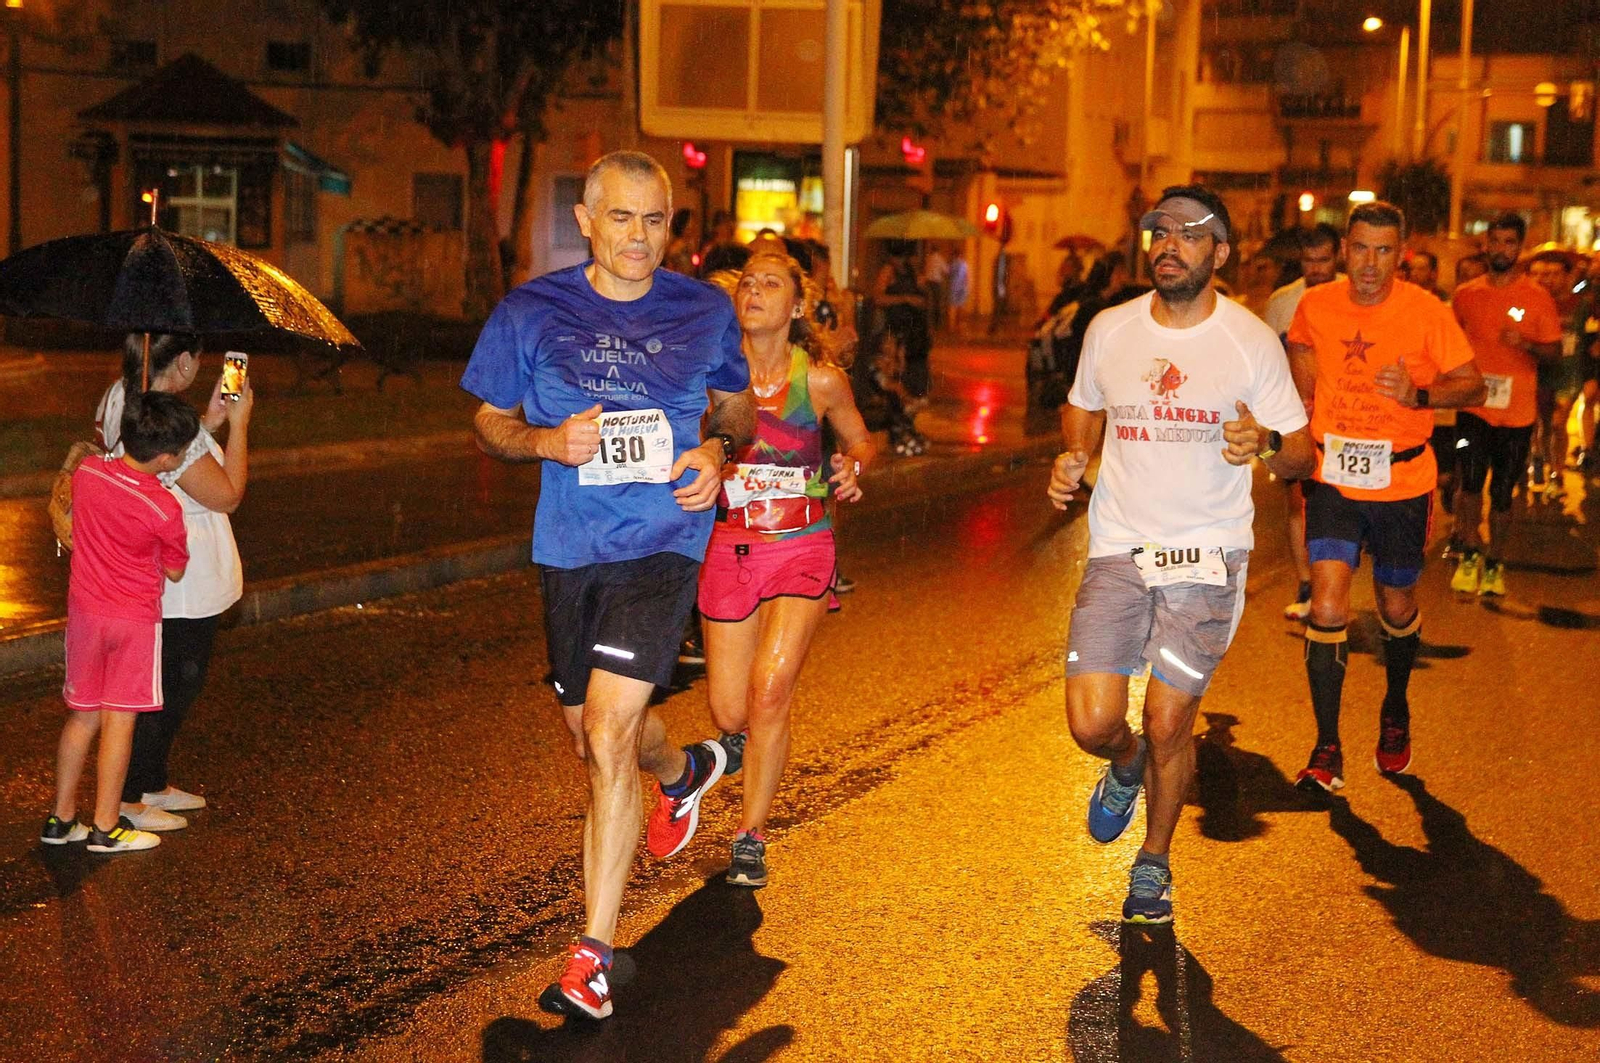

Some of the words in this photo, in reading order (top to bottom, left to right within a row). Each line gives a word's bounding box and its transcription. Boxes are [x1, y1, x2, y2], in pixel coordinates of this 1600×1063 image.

[581, 349, 647, 365] VUELTA
[607, 365, 620, 379] A
[580, 379, 648, 395] HUELVA
[603, 413, 660, 427] NOCTURNA
[1153, 405, 1220, 424] SANGRE
[601, 426, 614, 437] DE
[618, 423, 659, 436] HUELVA
[600, 436, 646, 464] 130
[1343, 442, 1385, 450] NOCTURNA
[1337, 453, 1371, 474] 123
[748, 467, 795, 477] NOTURNA
[1155, 547, 1200, 567] 500
